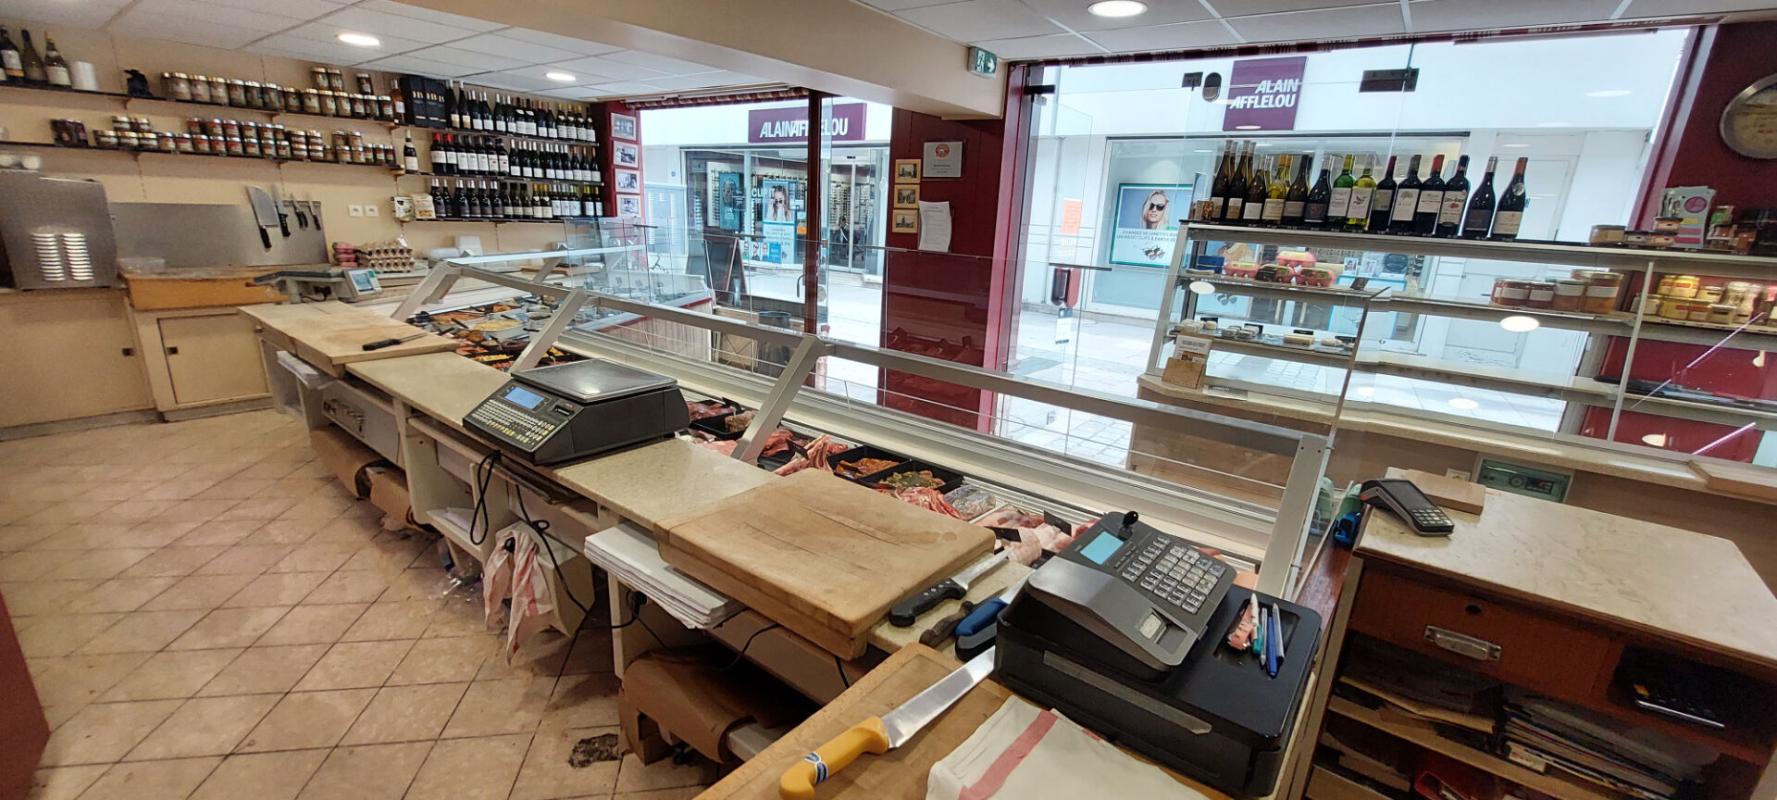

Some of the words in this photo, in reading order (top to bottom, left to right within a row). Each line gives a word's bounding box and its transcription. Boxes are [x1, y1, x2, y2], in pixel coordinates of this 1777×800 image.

[1255, 79, 1299, 94] ALAIN
[1230, 94, 1297, 109] AFFLELOU
[760, 121, 793, 138] ALAIN
